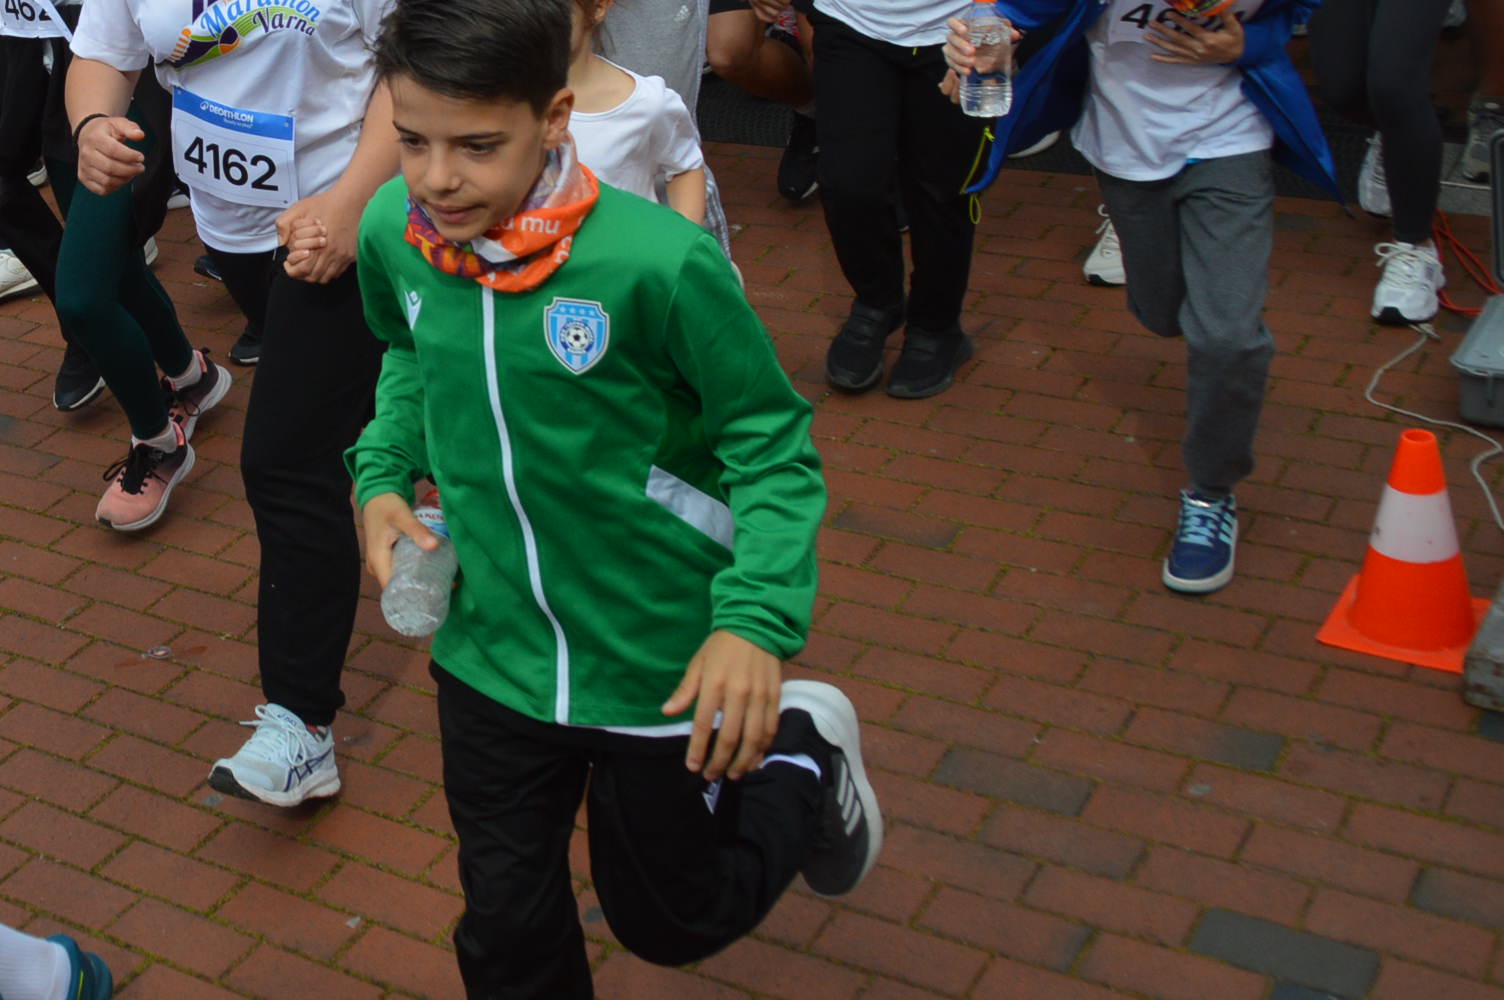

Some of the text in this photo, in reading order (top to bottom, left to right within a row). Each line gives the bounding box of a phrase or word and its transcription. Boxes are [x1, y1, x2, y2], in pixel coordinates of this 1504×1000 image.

[252, 8, 316, 36] Varna
[209, 104, 254, 123] DECATHLON
[184, 136, 279, 191] 4162
